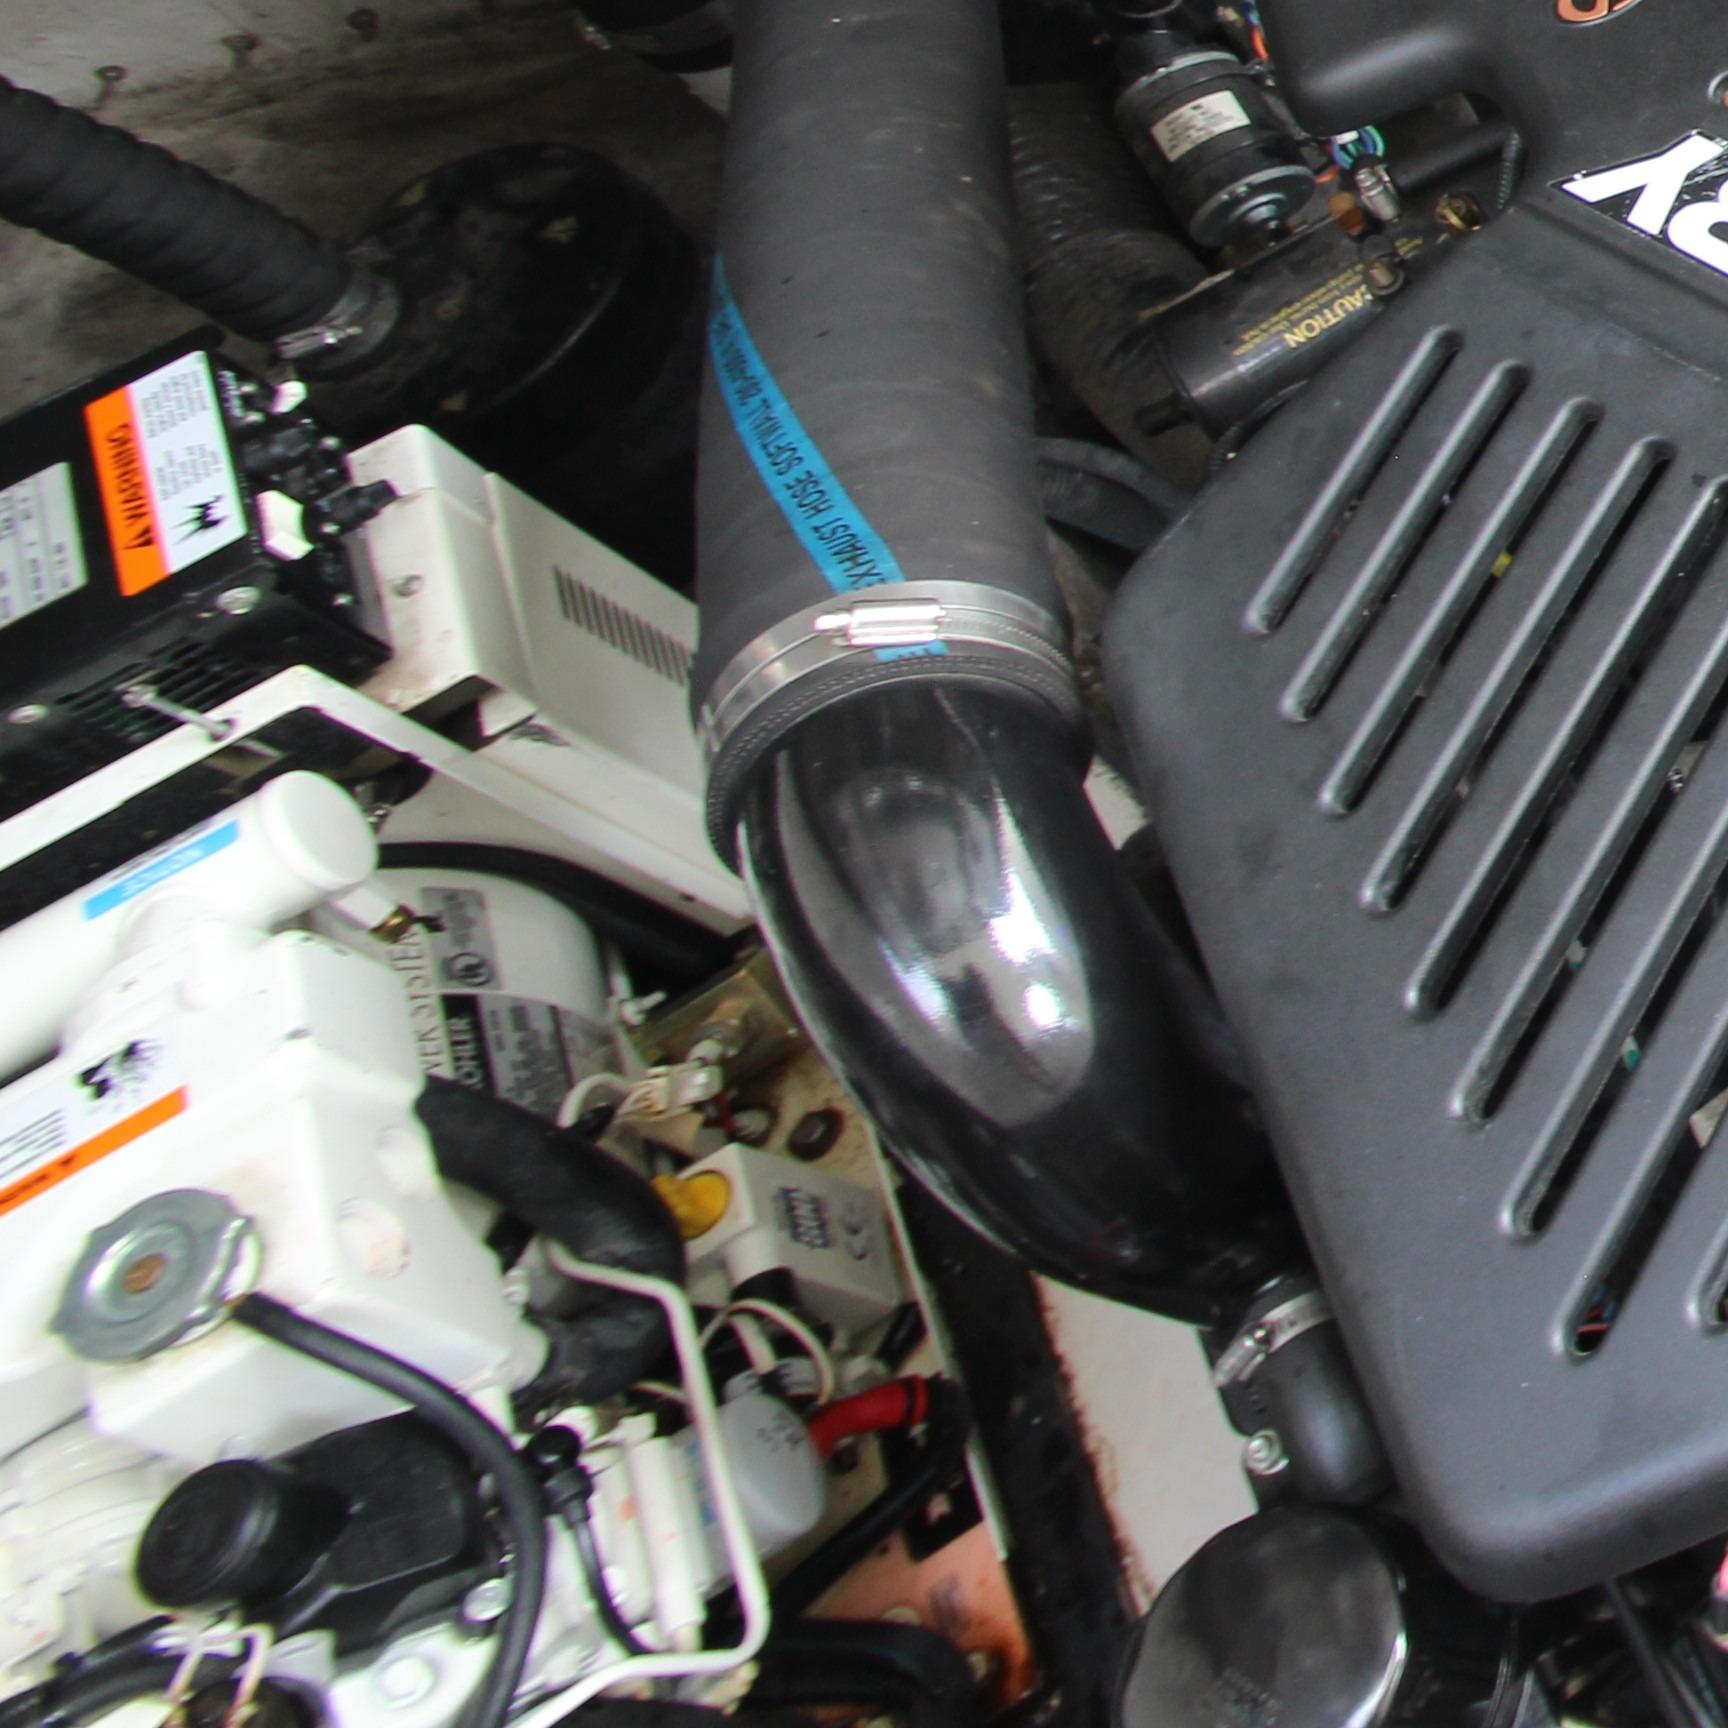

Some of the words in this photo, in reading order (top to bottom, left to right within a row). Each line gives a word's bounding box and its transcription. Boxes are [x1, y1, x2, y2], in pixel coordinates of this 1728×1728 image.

[107, 423, 148, 526] WARNING
[785, 471, 832, 518] HOSE
[448, 1018, 483, 1088] OHLER
